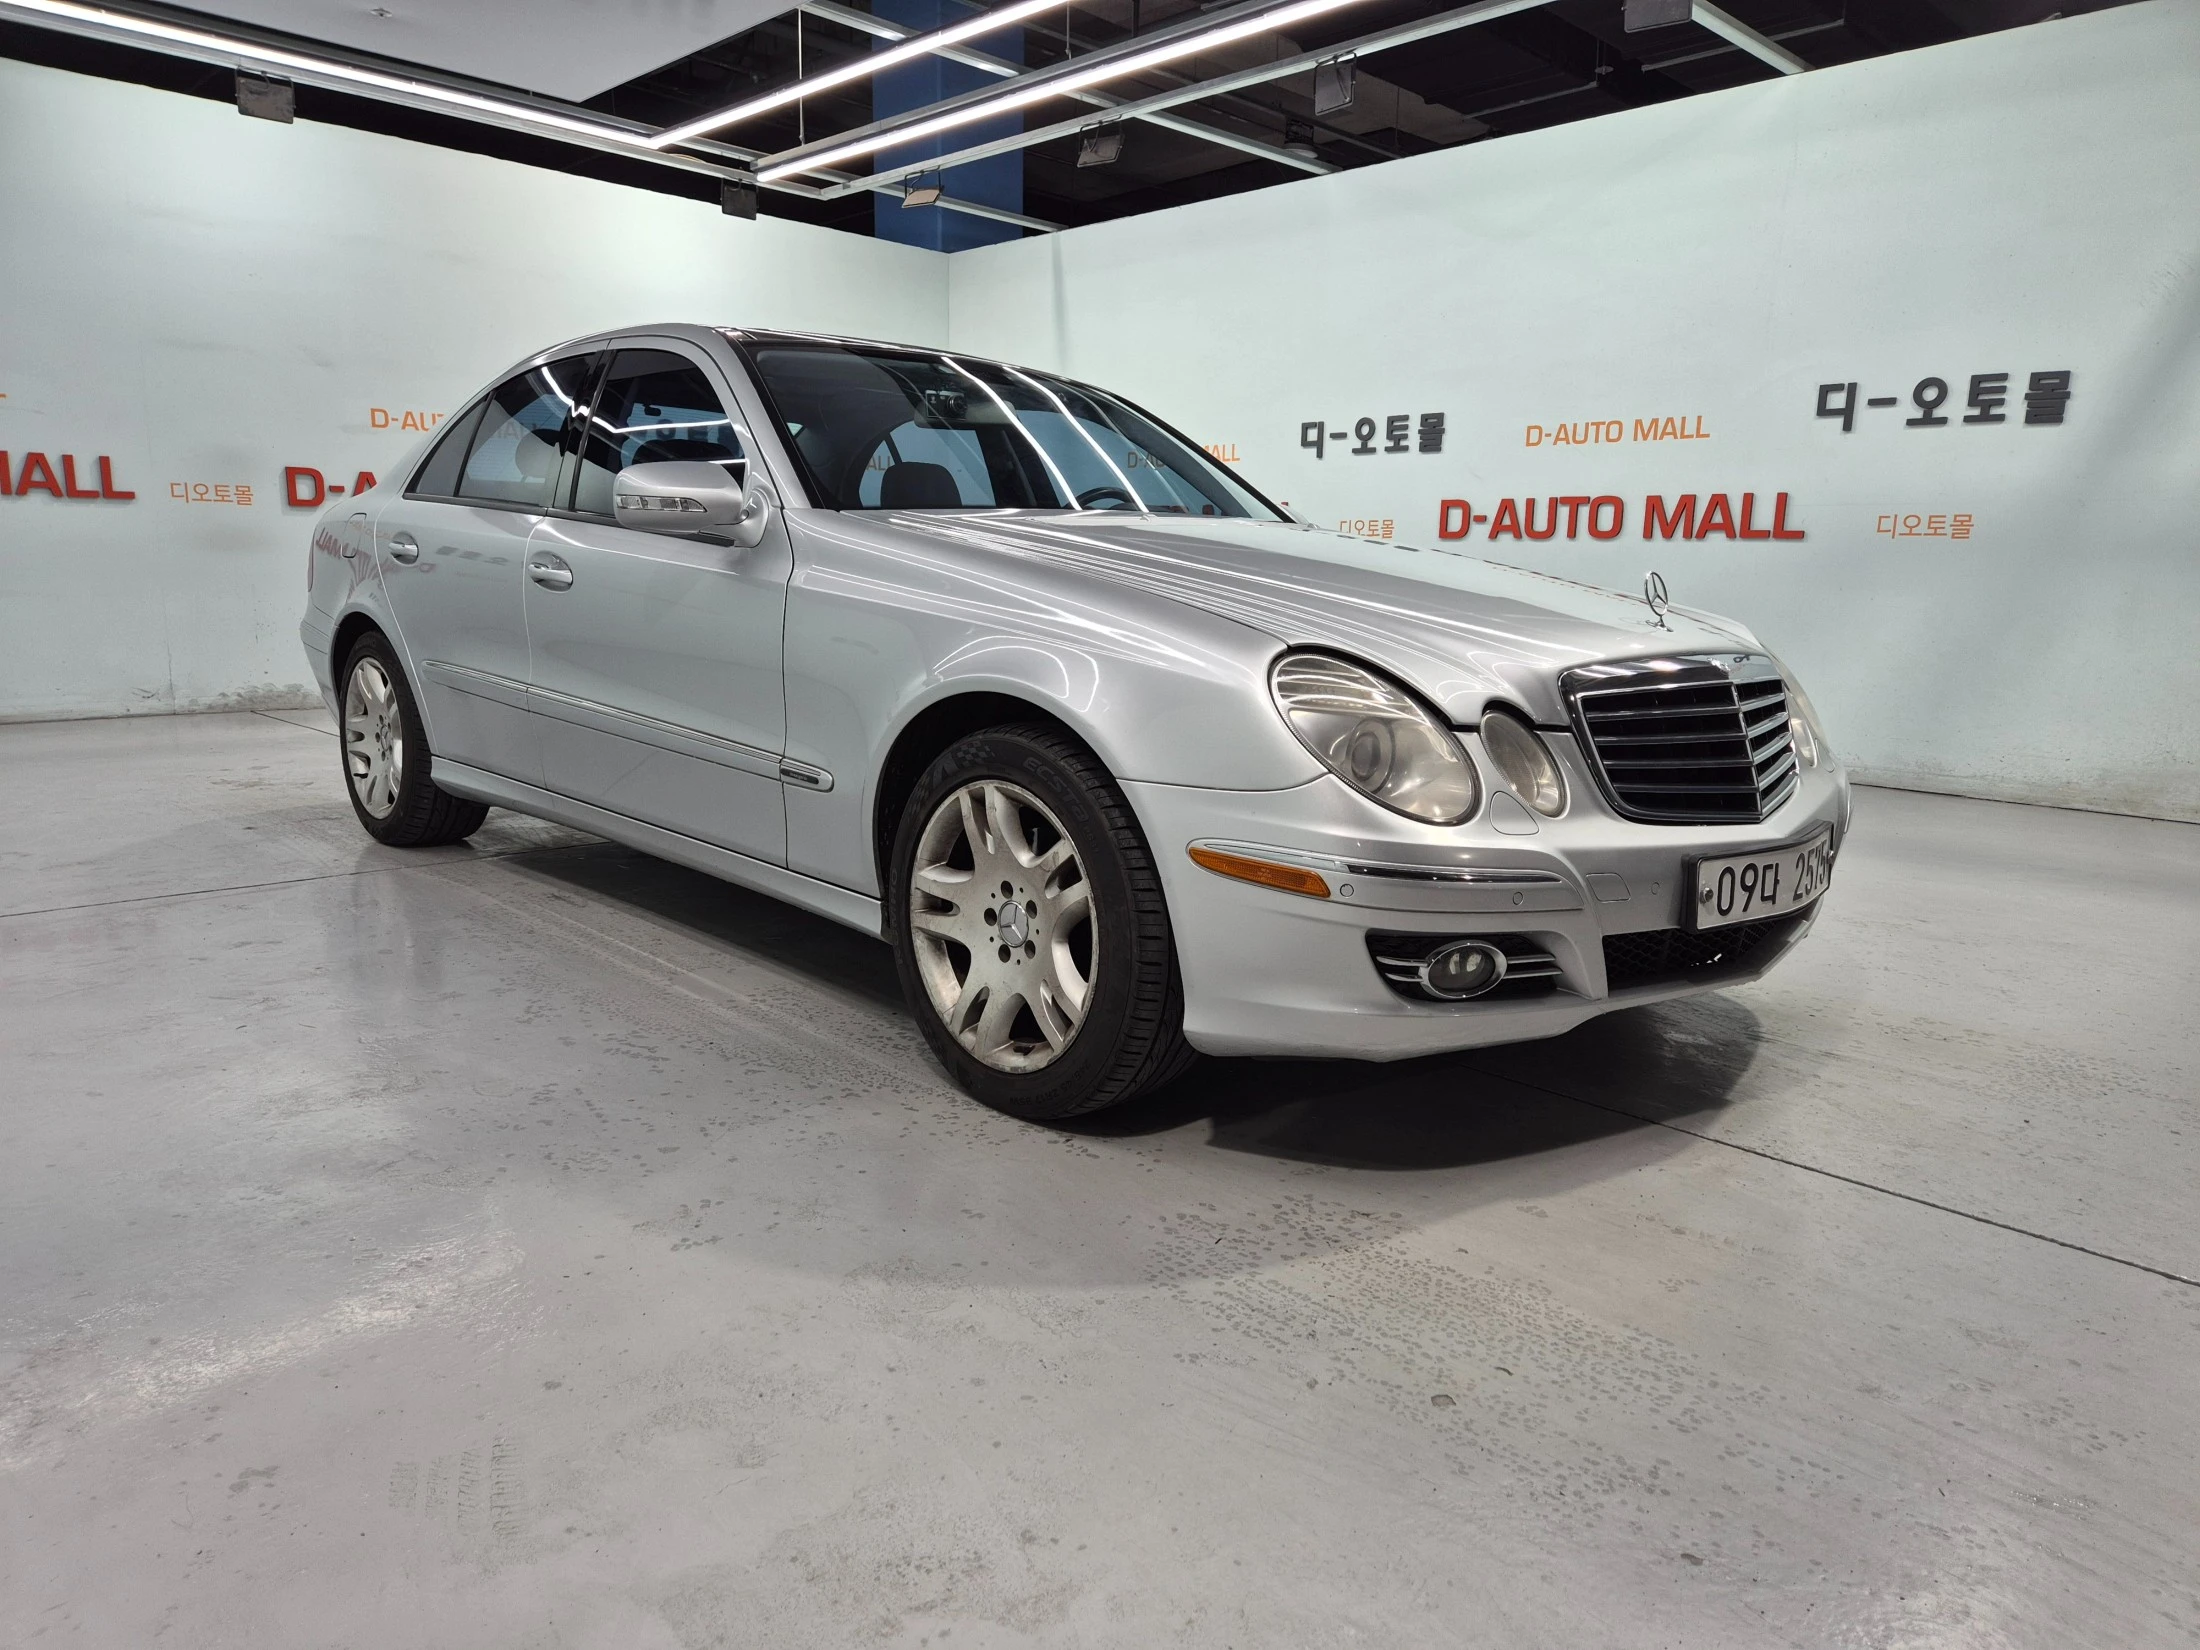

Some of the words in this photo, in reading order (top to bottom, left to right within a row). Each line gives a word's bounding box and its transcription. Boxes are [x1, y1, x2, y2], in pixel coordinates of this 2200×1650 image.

[1816, 370, 2071, 432] 디-오토몰
[1301, 412, 1445, 459] 디-오토몰
[1525, 420, 1623, 447] D-AUTO
[1633, 415, 1711, 442] MALL
[170, 481, 254, 506] 디오토몰
[1438, 495, 1624, 540] D-AUTO
[1643, 492, 1805, 540] MALL
[1876, 513, 1975, 539] 디오토몰
[1717, 862, 1780, 917] 09다
[1793, 839, 1828, 902] 2575
